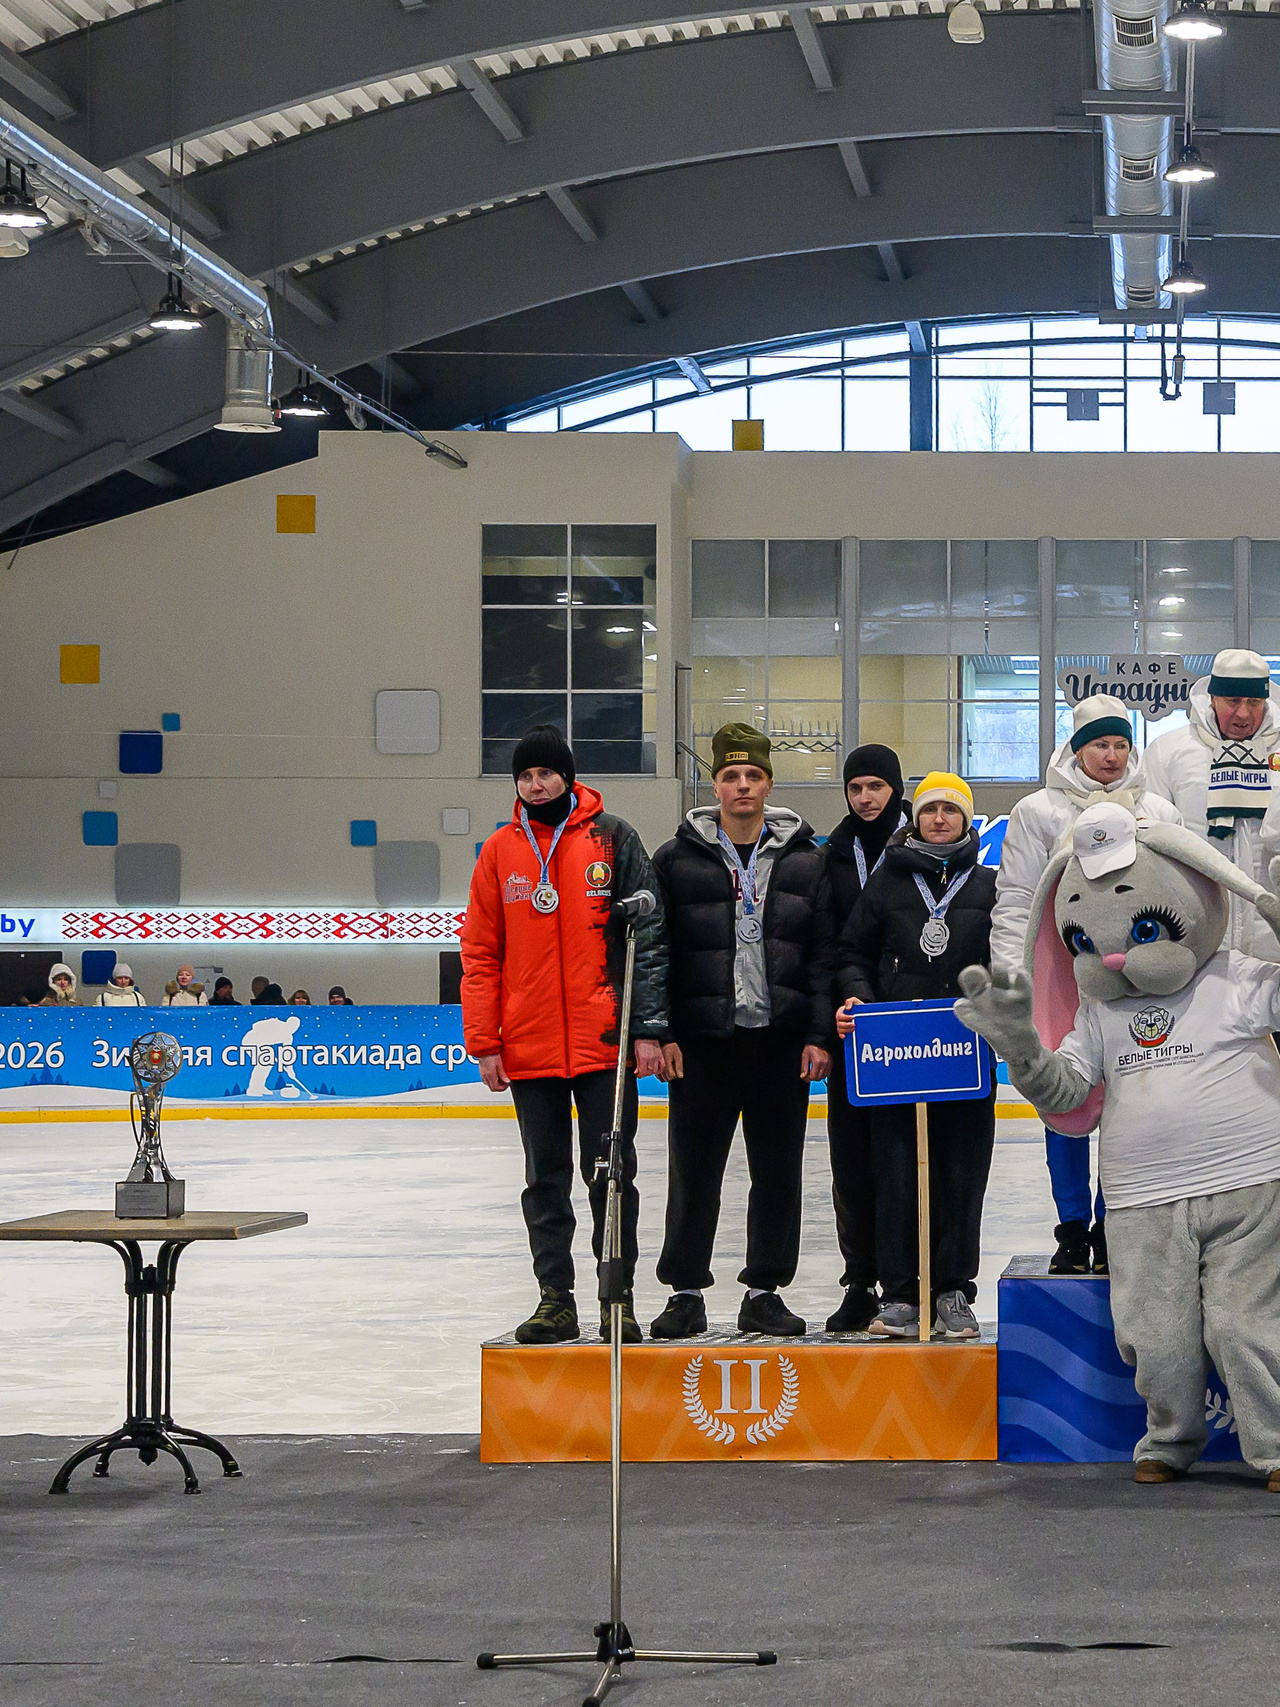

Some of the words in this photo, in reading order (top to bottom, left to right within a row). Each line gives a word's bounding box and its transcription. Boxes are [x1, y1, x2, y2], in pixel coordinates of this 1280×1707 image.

[1116, 661, 1176, 675] КАФЕ
[1210, 770, 1239, 784] БЕЛЫЕ
[1240, 771, 1268, 784] ТИГРЫ
[92, 1040, 212, 1068] Зияя
[221, 1043, 422, 1073] спартакиада
[861, 1037, 973, 1067] Агрохолдинг
[1118, 1049, 1152, 1066] БЕЛЫЕ
[1154, 1043, 1193, 1058] ТИГРЫ
[713, 1359, 768, 1414] II
